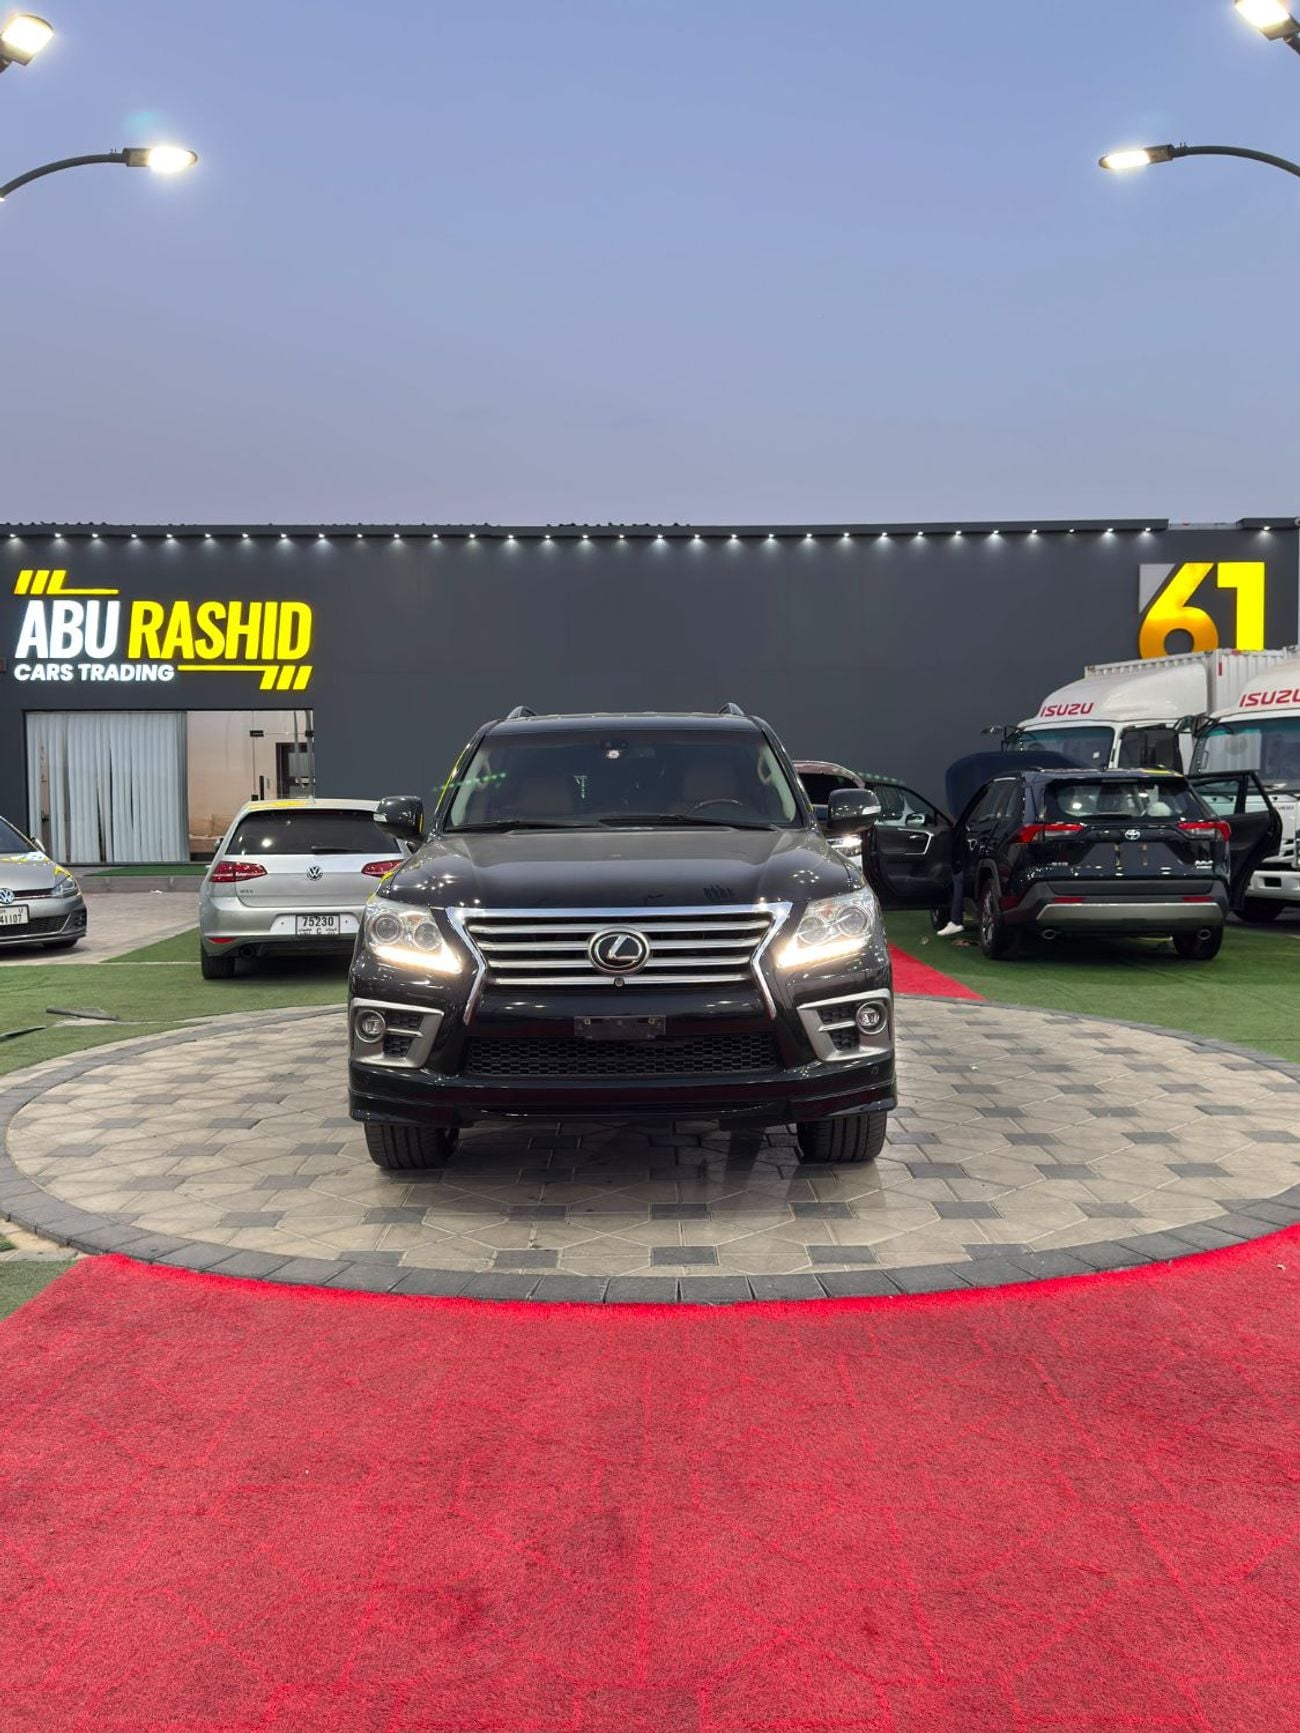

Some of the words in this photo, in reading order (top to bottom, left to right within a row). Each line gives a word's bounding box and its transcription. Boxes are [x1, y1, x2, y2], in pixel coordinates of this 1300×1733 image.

[1139, 562, 1265, 660] 61
[14, 600, 120, 659] ABU
[128, 601, 312, 660] RASHID
[14, 664, 74, 681] CARS
[78, 664, 175, 682] TRADING
[1040, 702, 1094, 718] ISUZU
[302, 916, 334, 927] 75230
